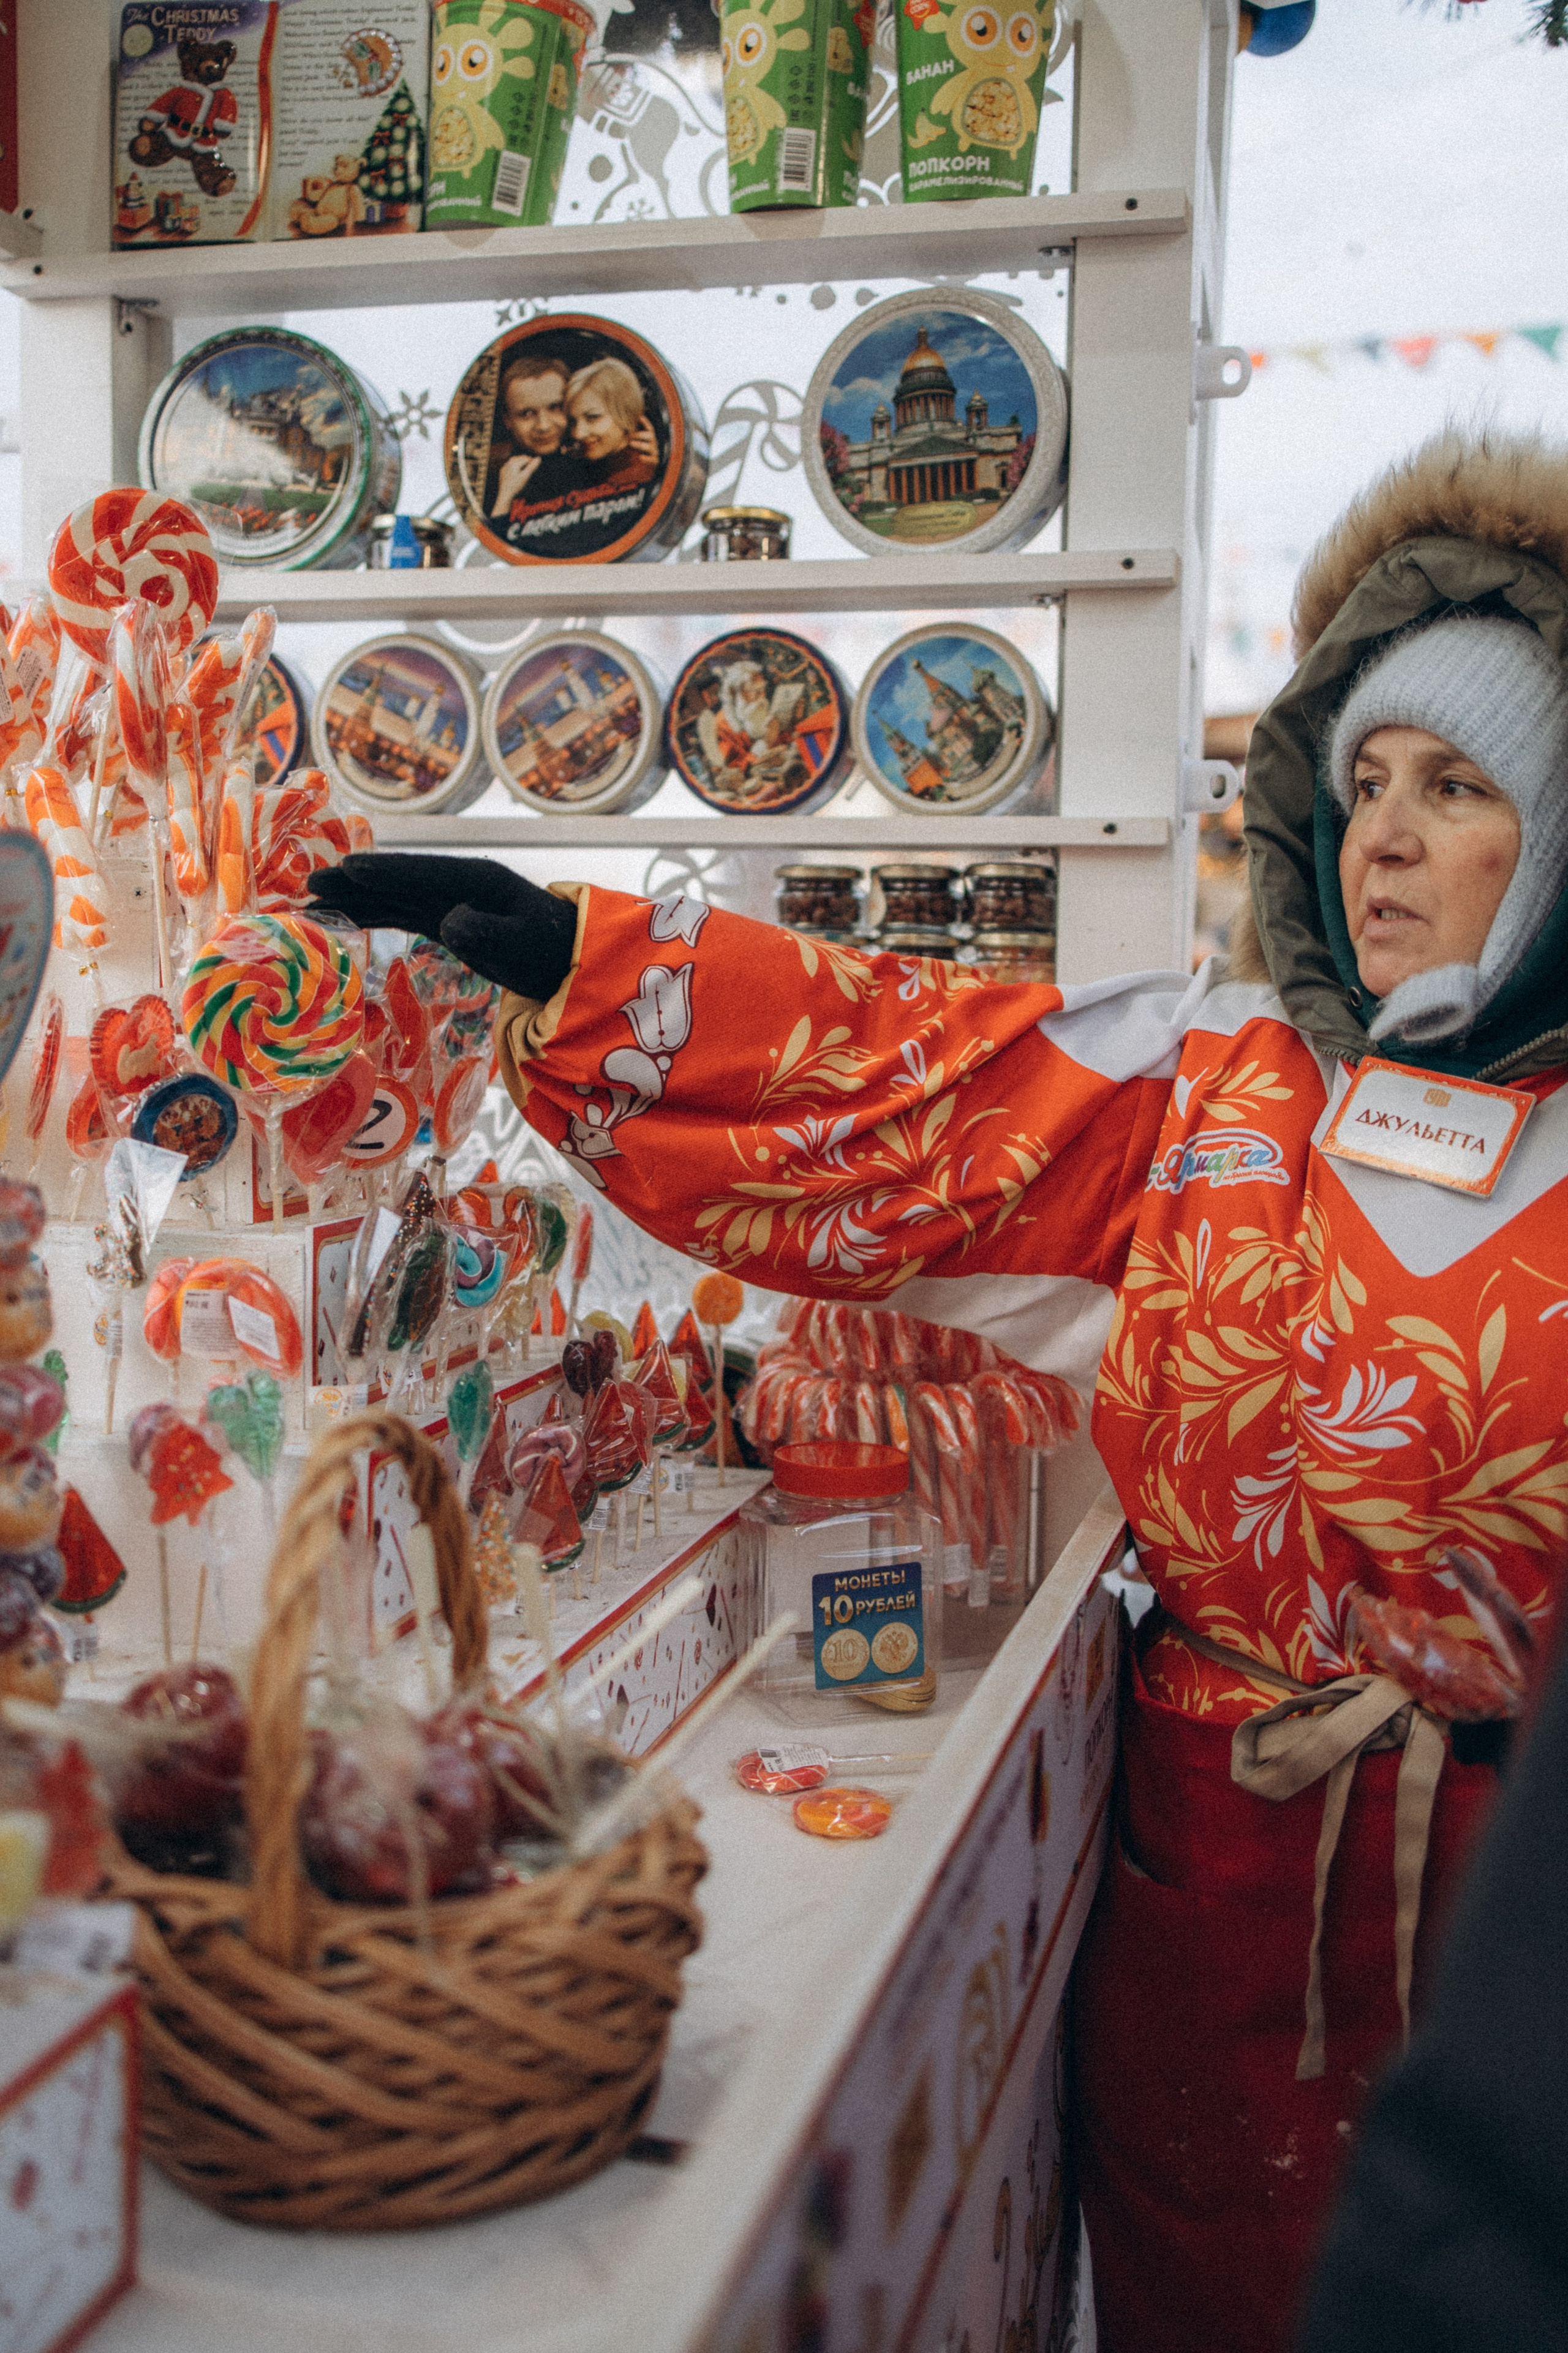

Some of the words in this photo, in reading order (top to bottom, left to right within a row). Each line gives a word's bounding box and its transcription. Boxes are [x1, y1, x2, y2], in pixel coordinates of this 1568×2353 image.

[151, 6, 239, 26] CHRISTMAS
[907, 59, 954, 85] БАНАН
[909, 155, 990, 178] ПОПКОРН
[1355, 1108, 1485, 1154] ДЖУЛЬЕТТА
[834, 1569, 905, 1592] МОНЕТЫ
[818, 1594, 854, 1625] 10
[856, 1590, 916, 1615] РУБЛЕЙ
[832, 1638, 859, 1662] 10
